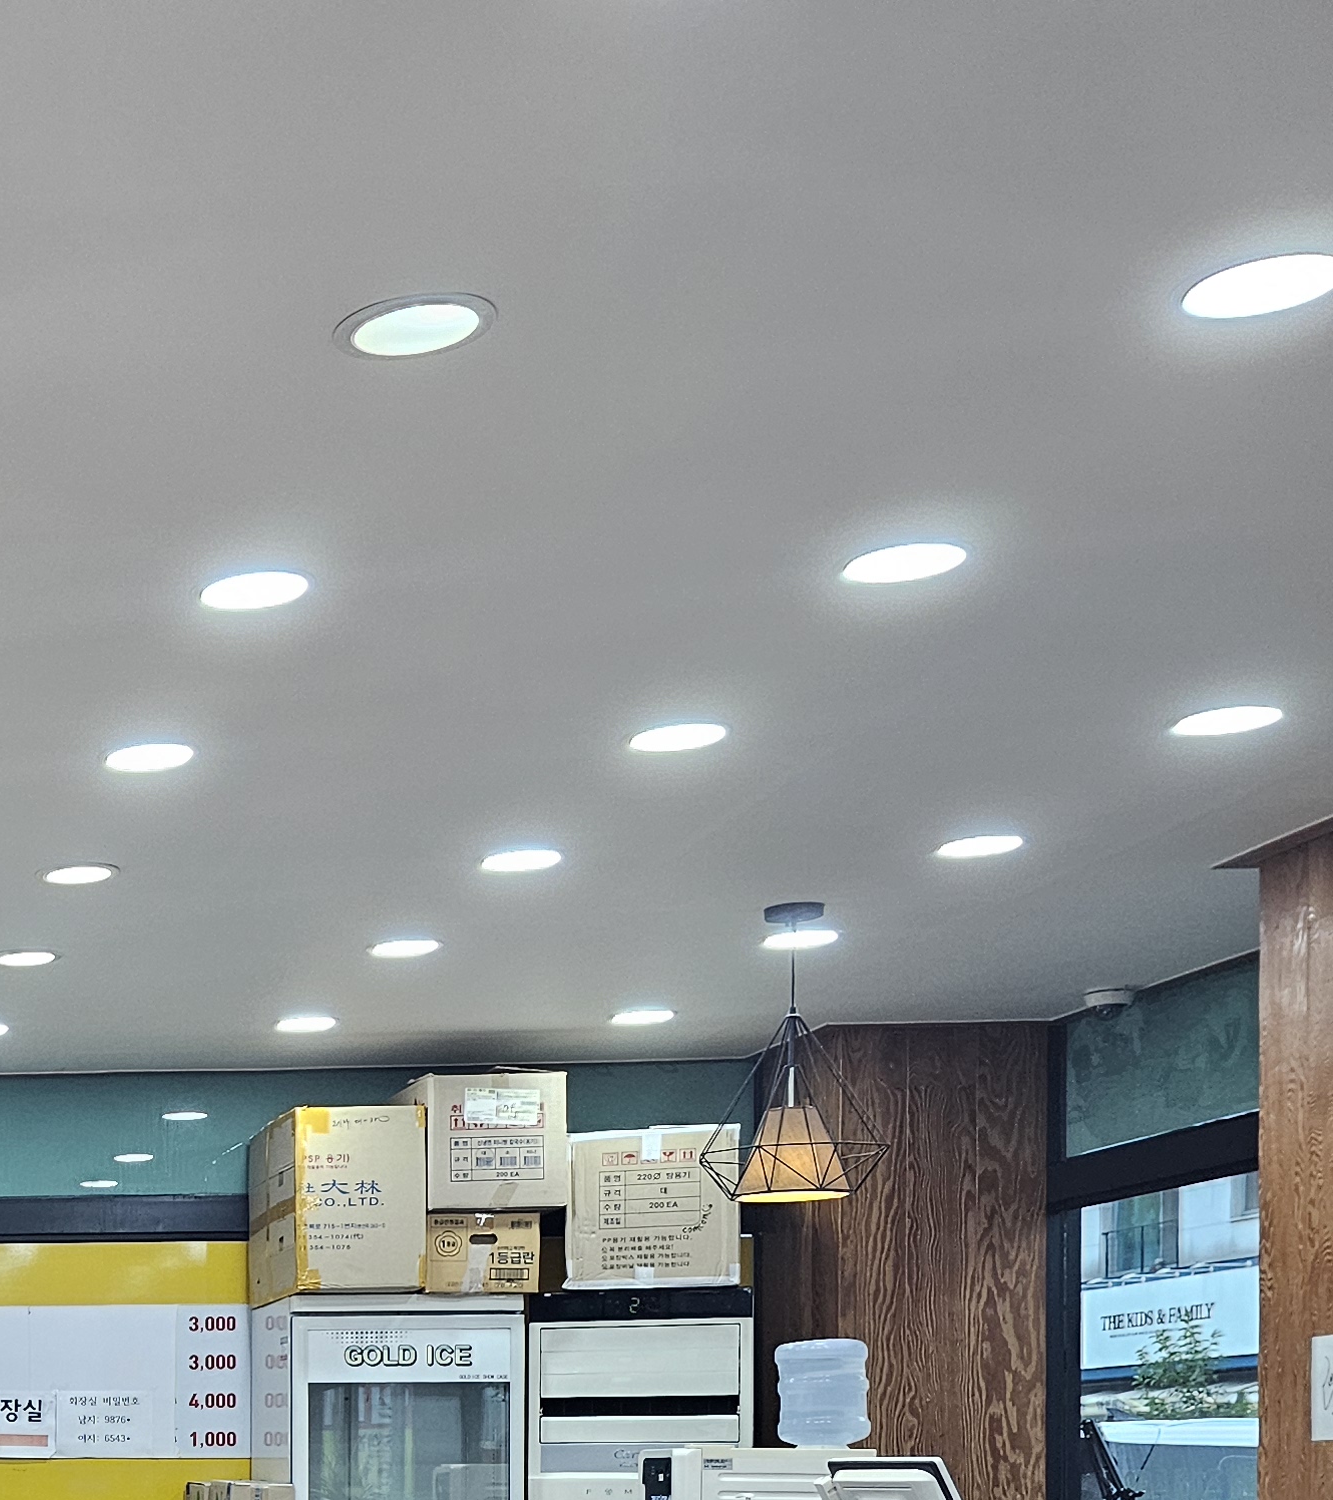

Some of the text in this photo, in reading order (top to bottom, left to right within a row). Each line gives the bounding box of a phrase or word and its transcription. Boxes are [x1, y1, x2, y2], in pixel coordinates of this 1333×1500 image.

[648, 1201, 665, 1209] 200
[489, 1251, 535, 1265] 1등급란
[188, 1316, 237, 1334] 3,000
[1100, 1302, 1215, 1331] THE KIDS & FAMILY
[188, 1354, 237, 1372] 3,000
[344, 1344, 473, 1368] GOLD ICE
[188, 1392, 237, 1411] 4,000
[189, 1431, 237, 1449] 1,000
